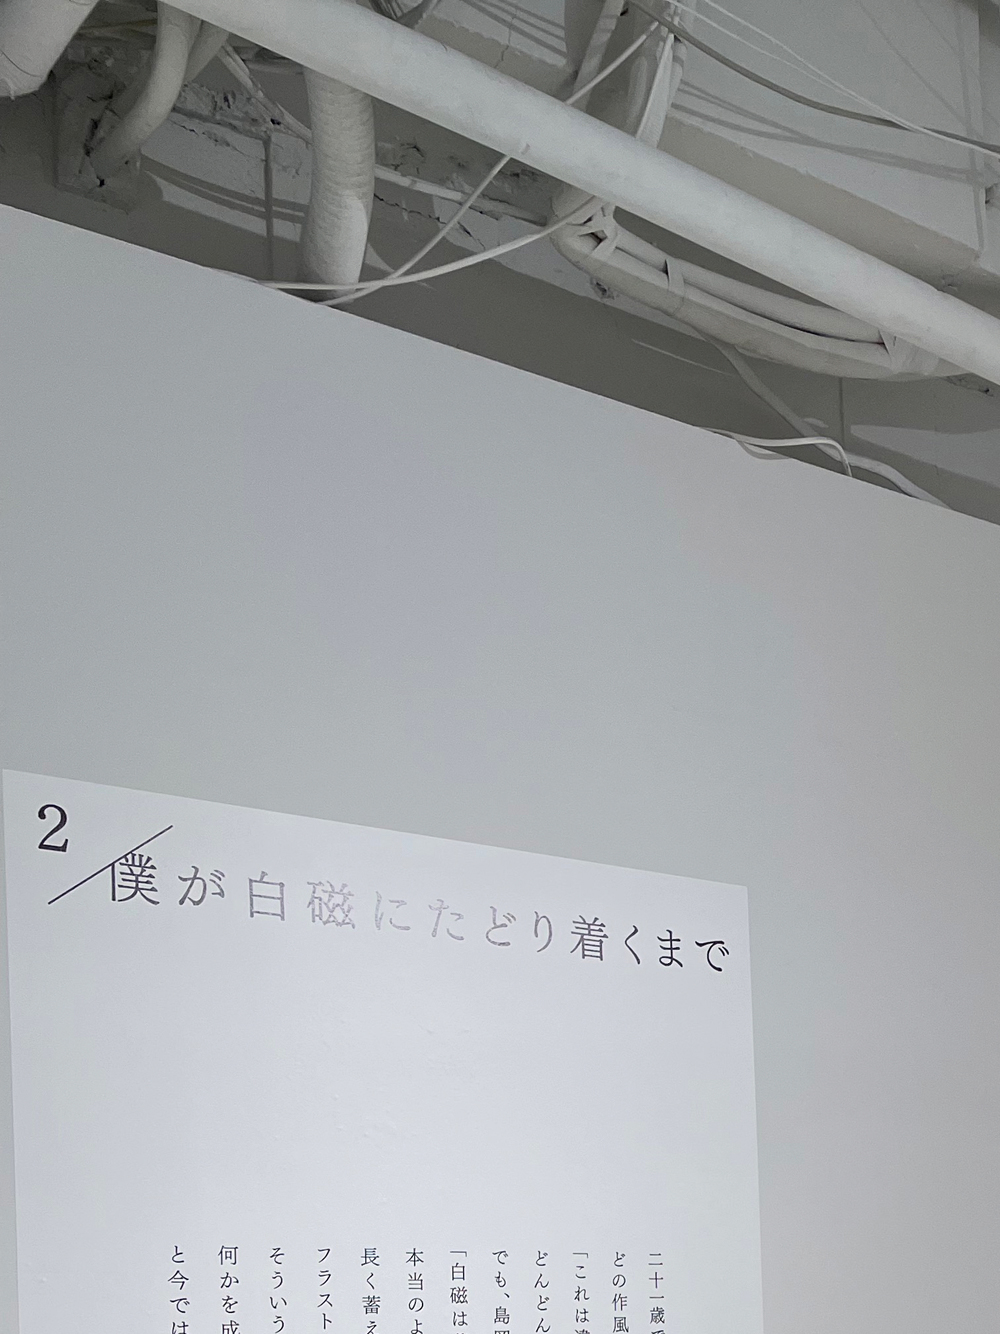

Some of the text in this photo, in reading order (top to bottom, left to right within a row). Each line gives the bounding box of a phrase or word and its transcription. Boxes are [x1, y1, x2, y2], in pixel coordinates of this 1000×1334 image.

[37, 803, 69, 853] 2
[110, 851, 731, 973] 僕が白磁にたどり着くまで
